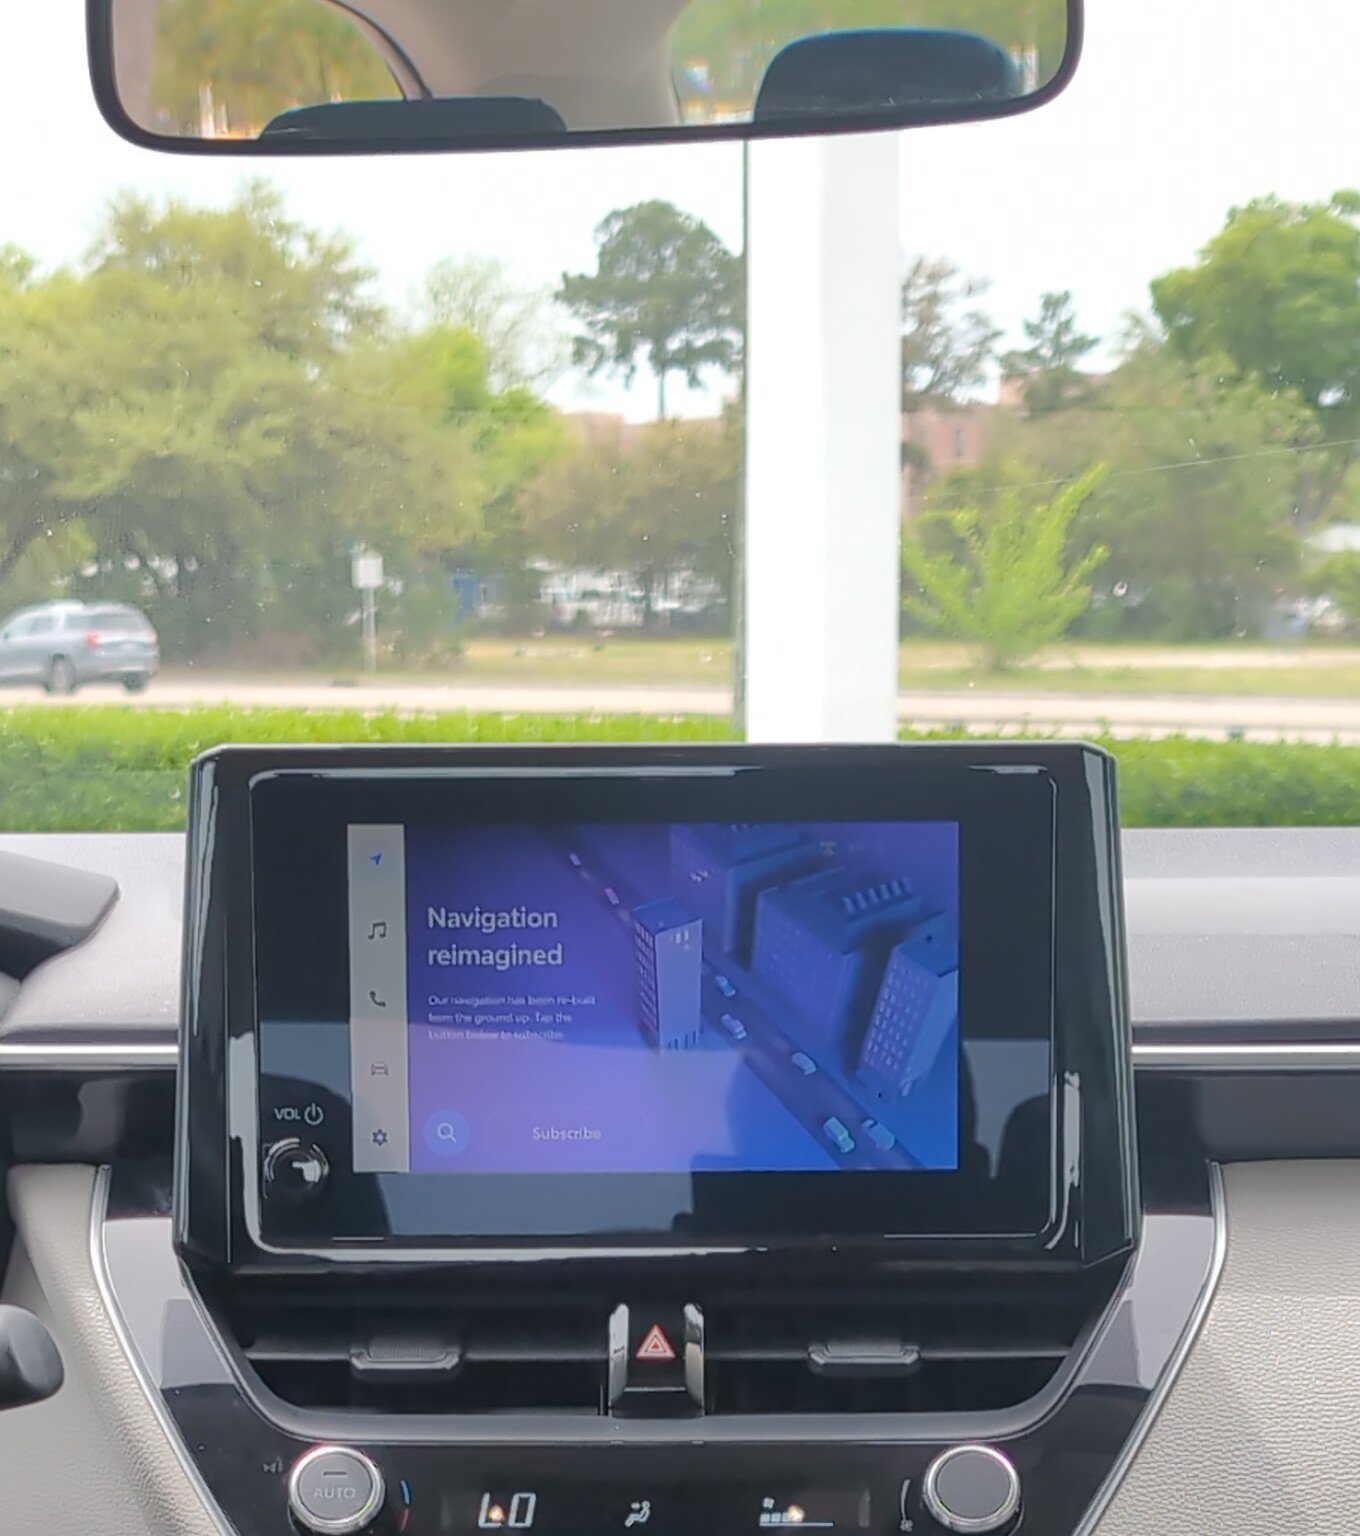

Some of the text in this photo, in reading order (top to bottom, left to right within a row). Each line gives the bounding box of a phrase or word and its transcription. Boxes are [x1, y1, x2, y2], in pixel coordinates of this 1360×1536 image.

[427, 905, 559, 934] Navigation
[427, 941, 563, 972] reimagined
[428, 995, 448, 1006] Our
[450, 995, 506, 1008] navigation
[507, 994, 526, 1006] has
[528, 994, 554, 1006] been
[455, 1012, 472, 1024] the
[474, 1013, 513, 1026] ground
[555, 1012, 573, 1024] the
[500, 1030, 513, 1041] to
[274, 1107, 301, 1121] VOL
[532, 1126, 602, 1141] Subscribe
[312, 1486, 357, 1500] AUTO
[478, 1492, 537, 1529] LO
